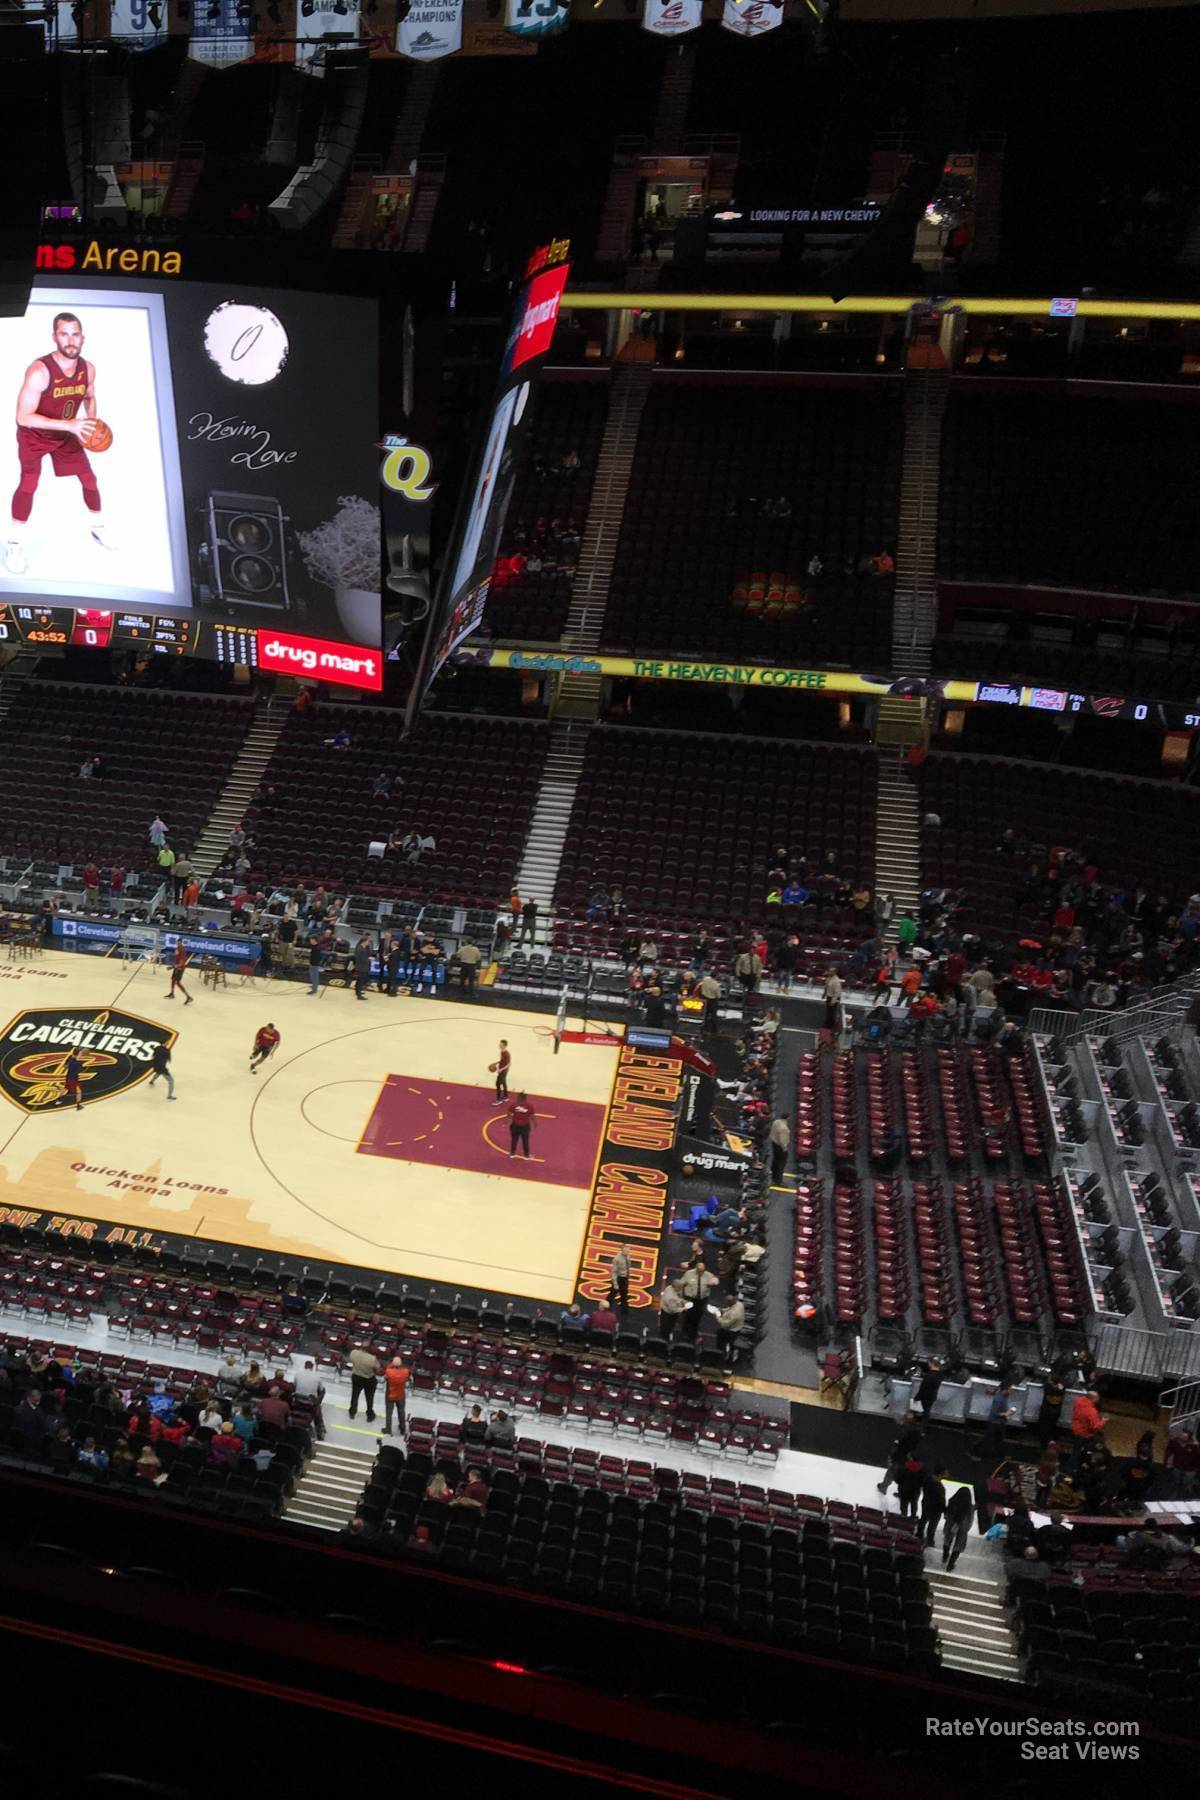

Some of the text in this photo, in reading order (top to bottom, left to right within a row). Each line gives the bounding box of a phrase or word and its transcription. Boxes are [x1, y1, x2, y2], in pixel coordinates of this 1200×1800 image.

[749, 210, 881, 222] LOOKING FOR A NEW CHEVY?
[82, 241, 182, 274] Arena
[382, 445, 434, 501] Q
[18, 608, 32, 619] 1Q
[27, 631, 67, 643] 43:52
[85, 629, 98, 644] 0
[264, 640, 317, 668] drug
[320, 652, 376, 676] mart
[633, 662, 827, 688] THE HEAVENLY COFFEE
[1134, 704, 1148, 720] 0
[78, 924, 120, 938] Cleveland
[183, 938, 250, 955] Cleveland Clinic
[16, 967, 68, 979] Loans
[58, 1018, 134, 1037] CLEVELAND
[9, 1022, 162, 1062] CAVALIERS
[682, 1153, 714, 1169] drug
[69, 1162, 230, 1196] Quicken Loans
[106, 1180, 172, 1197] Arena
